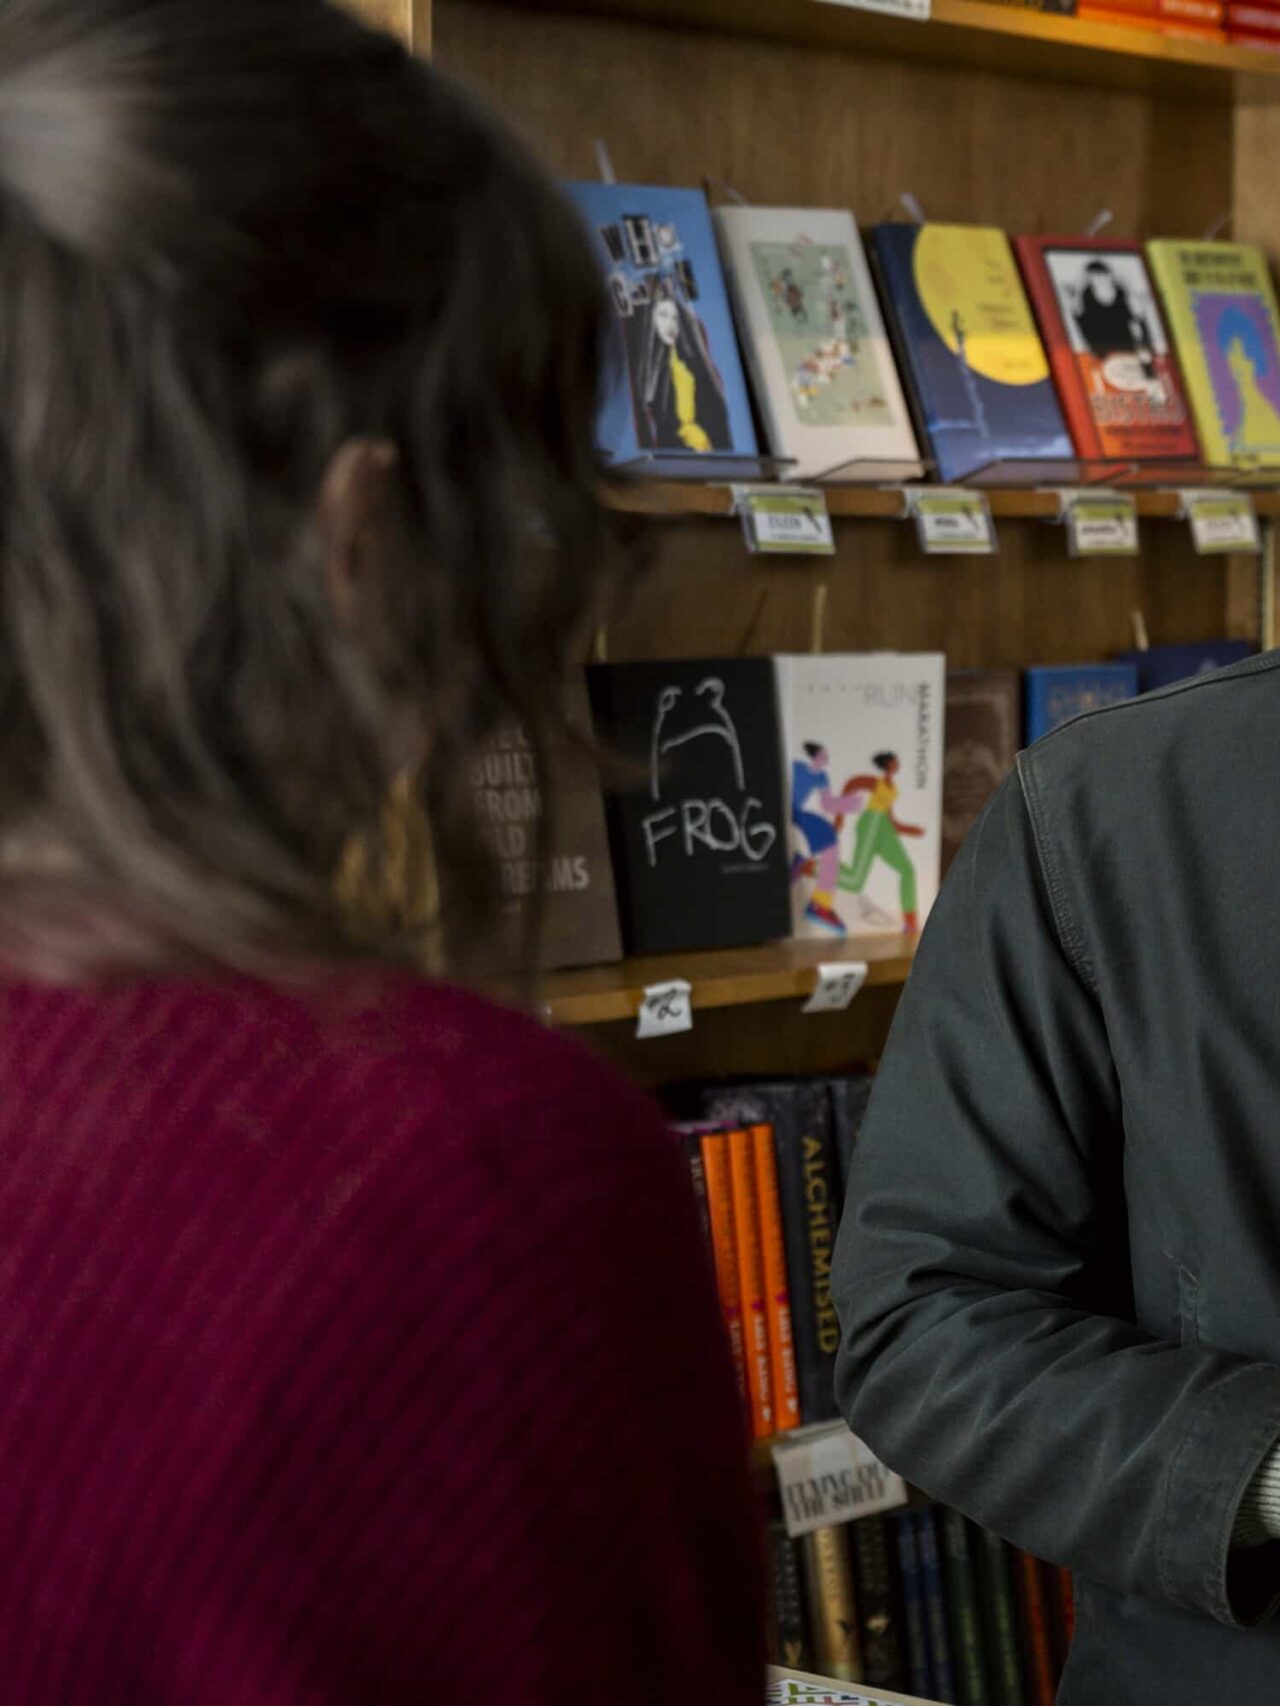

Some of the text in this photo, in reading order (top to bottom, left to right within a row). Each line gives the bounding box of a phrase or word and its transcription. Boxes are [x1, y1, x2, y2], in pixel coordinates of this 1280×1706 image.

[864, 682, 918, 709] RUN
[916, 681, 931, 790] MARATHON
[641, 799, 776, 866] FROG
[801, 1136, 838, 1354] ALCHEMISED
